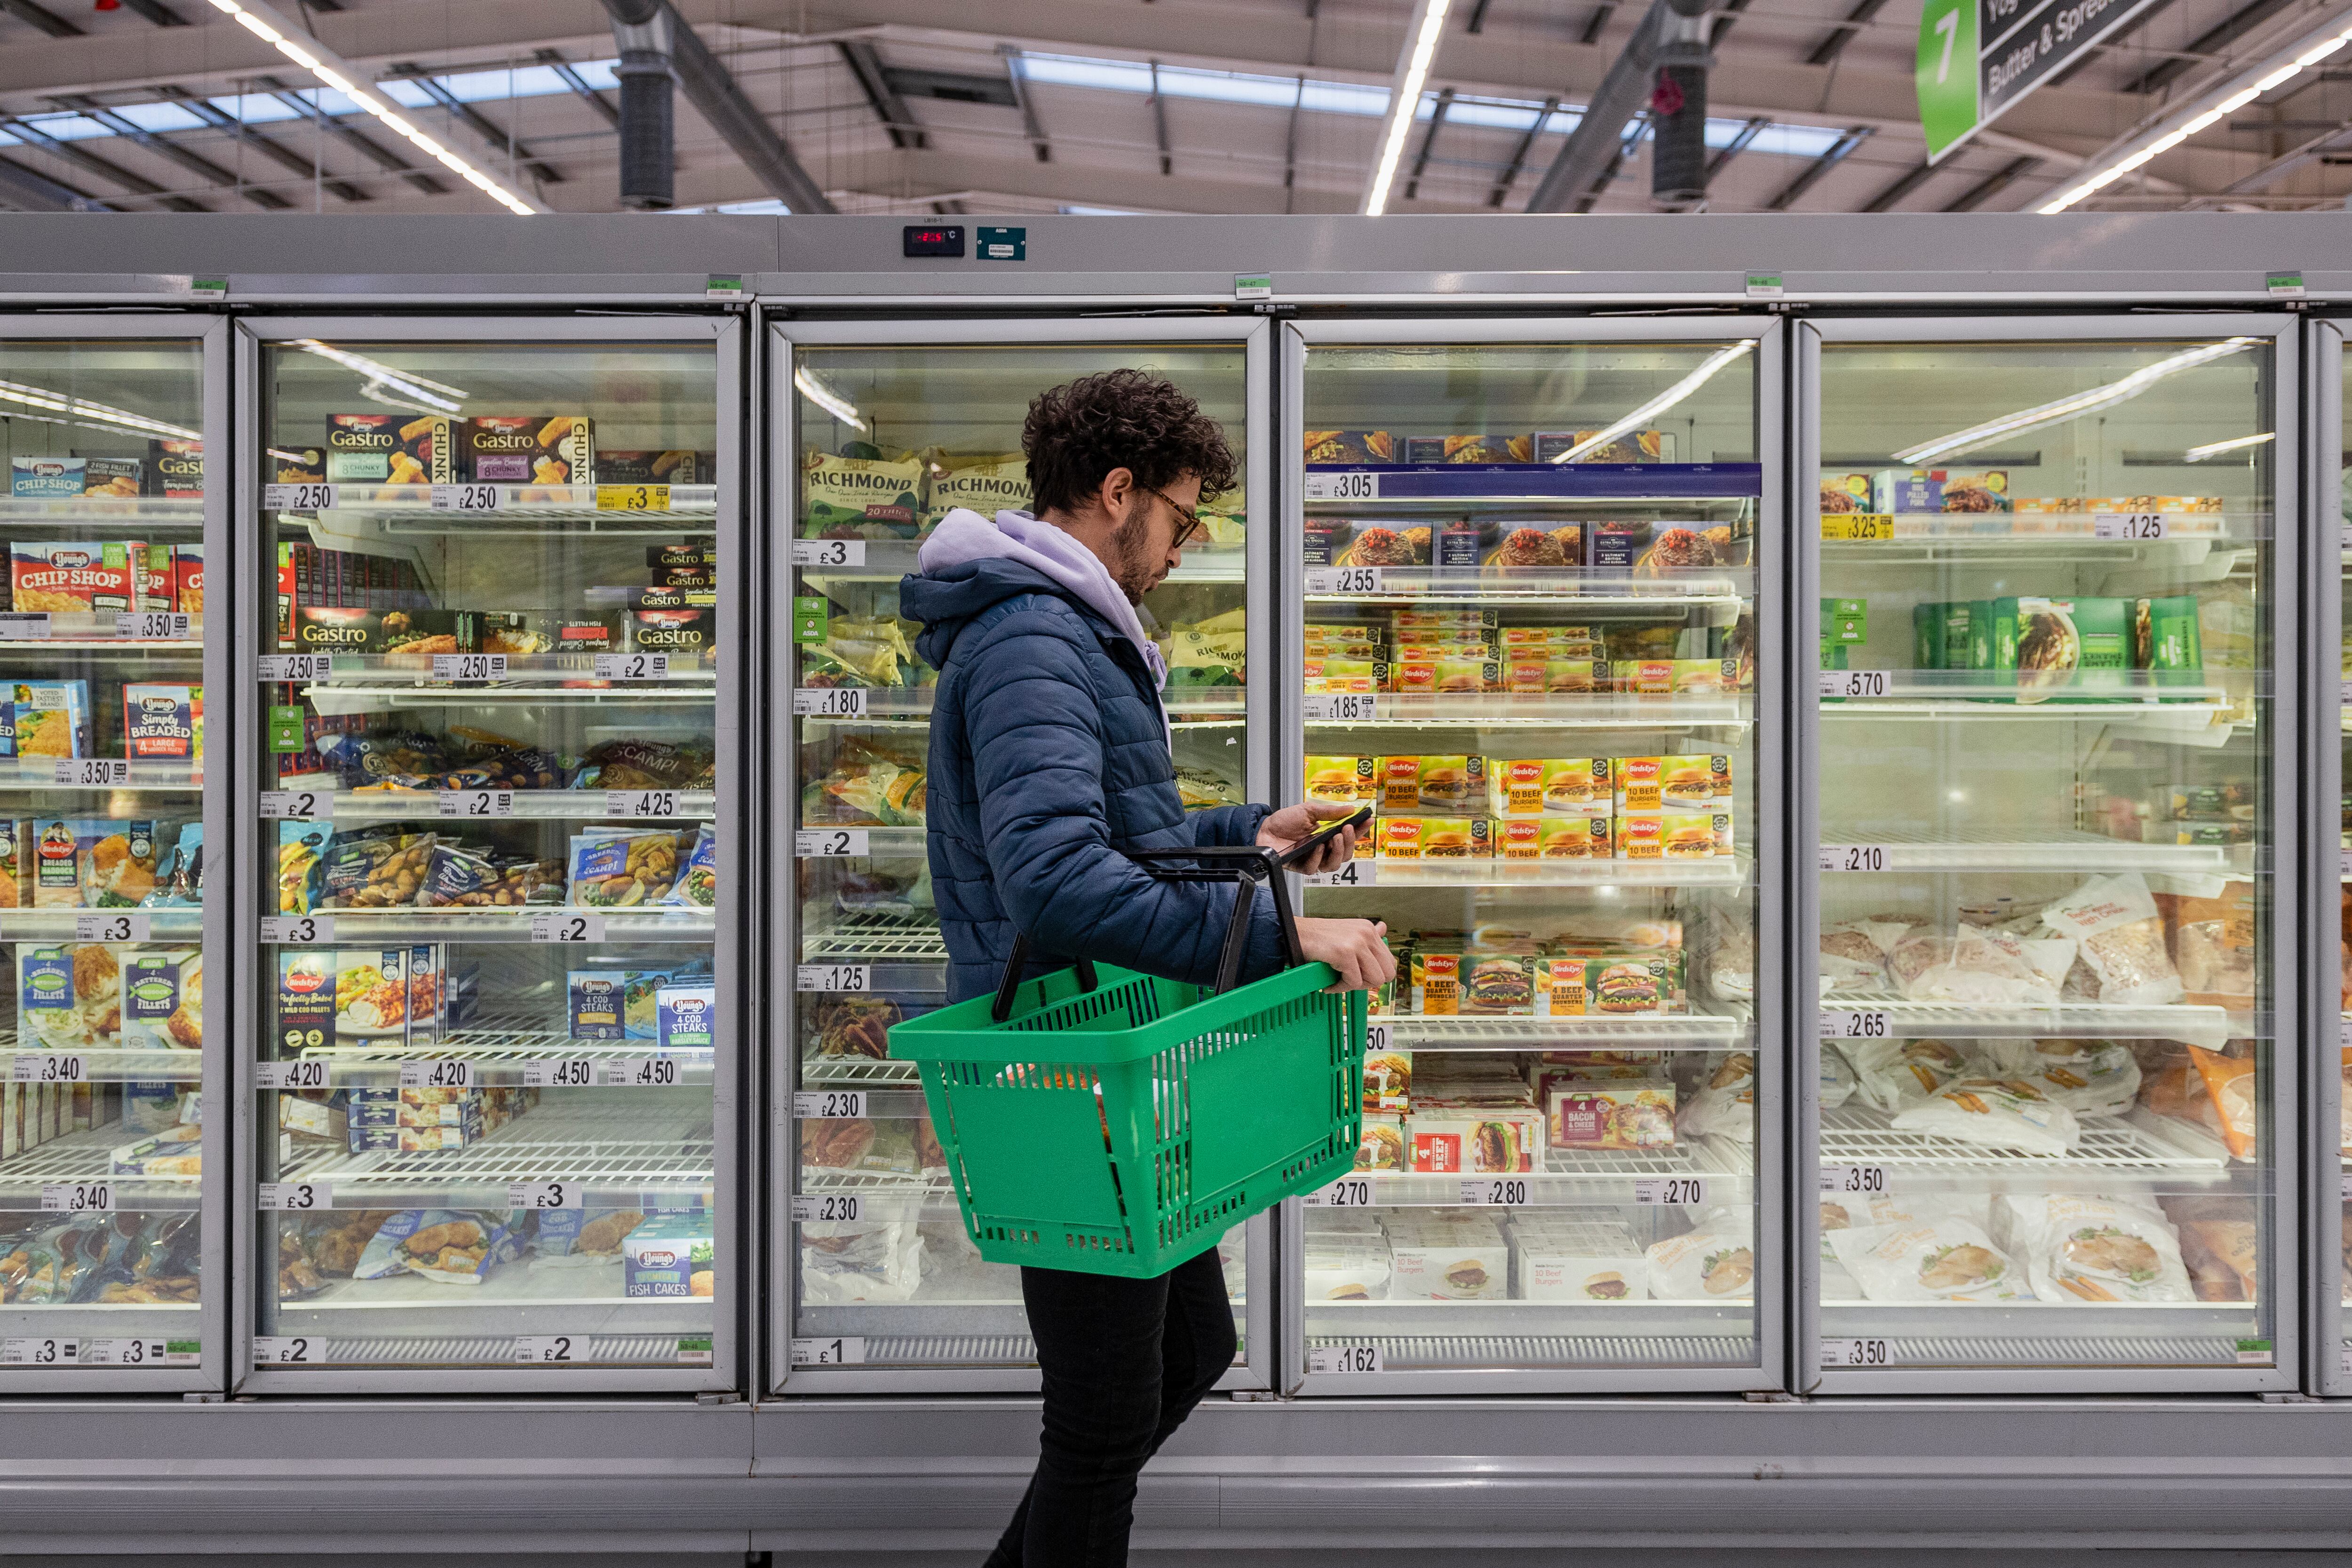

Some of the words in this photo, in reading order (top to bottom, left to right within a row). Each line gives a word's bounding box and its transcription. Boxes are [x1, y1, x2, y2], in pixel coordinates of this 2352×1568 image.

[1935, 8, 1959, 83] 7
[1989, 39, 2038, 94] Butter
[2040, 24, 2053, 55] &
[331, 431, 393, 447] Gastro
[474, 433, 533, 449] Gastro
[16, 479, 48, 490] CHIP
[48, 478, 80, 491] SHOP
[810, 471, 912, 491] RICHMOND
[1334, 475, 1371, 497] £3.05
[294, 486, 330, 508] £2.50
[460, 486, 496, 509] £2.50
[628, 488, 647, 509] £3
[882, 508, 910, 518] THICK
[1848, 517, 1876, 538] £3.25
[2123, 516, 2161, 538] £1.25
[661, 554, 698, 564] Gastro
[820, 541, 846, 564] £3
[21, 571, 68, 589] CHIP
[71, 571, 122, 589] SHOP
[667, 576, 704, 585] Gastro
[1337, 569, 1374, 591] £2.55
[641, 595, 679, 605] Gastro
[143, 614, 170, 636] £3.50
[303, 625, 366, 643] Gastro
[637, 629, 701, 644] Gastro
[284, 657, 312, 678] £2.50
[460, 657, 487, 678] £2.50
[625, 656, 644, 677] £2
[1846, 673, 1882, 695] £5.70
[822, 691, 858, 713] £1.80
[1329, 696, 1357, 718] £1.85
[131, 726, 191, 738] BREADED
[141, 715, 178, 728] Simply
[140, 741, 147, 752] 4
[81, 762, 109, 784] £3.50
[1512, 768, 1539, 776] BirdsEye
[1629, 764, 1656, 773] BirdsEye
[288, 794, 315, 816] £2
[470, 793, 489, 815] £2
[636, 793, 672, 815] £4.25
[824, 832, 850, 855] £2
[584, 861, 618, 874] SCAMPI
[1845, 848, 1881, 870] £2.10
[1331, 862, 1359, 885] £4
[104, 917, 131, 940] £3
[289, 919, 315, 941] £3
[560, 918, 586, 940] £2
[826, 967, 862, 990] £1.25
[33, 988, 65, 999] FILLETS
[137, 999, 170, 1009] FILLETS
[310, 993, 333, 1003] Baked
[581, 1004, 613, 1012] STEAKS
[676, 1000, 704, 1012] Young's
[672, 1023, 707, 1033] STEAKS
[1847, 1014, 1883, 1036] £2.65
[42, 1058, 79, 1080] £3.40
[285, 1063, 322, 1086] £4.20
[429, 1063, 465, 1085] £4.20
[553, 1061, 589, 1084] £4.50
[637, 1061, 673, 1084] £4.50
[822, 1093, 858, 1116] £2.30
[1578, 1102, 1586, 1111] 4
[1568, 1113, 1596, 1122] BACON
[1419, 1149, 1430, 1159] 4
[1846, 1168, 1882, 1191] £3.50
[70, 1186, 107, 1209] £3.40
[287, 1186, 313, 1208] £3
[537, 1184, 563, 1207] £3
[1331, 1182, 1367, 1205] £2.70
[1488, 1181, 1525, 1204] £2.80
[1663, 1180, 1700, 1203] £2.70
[820, 1197, 857, 1220] £2.30
[644, 1252, 674, 1266] Young's
[630, 1284, 650, 1295] FISH
[655, 1283, 686, 1295] CAKES
[36, 1340, 56, 1362] £3
[123, 1340, 143, 1362] £3
[281, 1339, 307, 1361] £2
[544, 1337, 570, 1361] £2
[819, 1339, 842, 1363] £1
[1338, 1348, 1375, 1371] £1.62
[1850, 1340, 1885, 1363] £3.50
